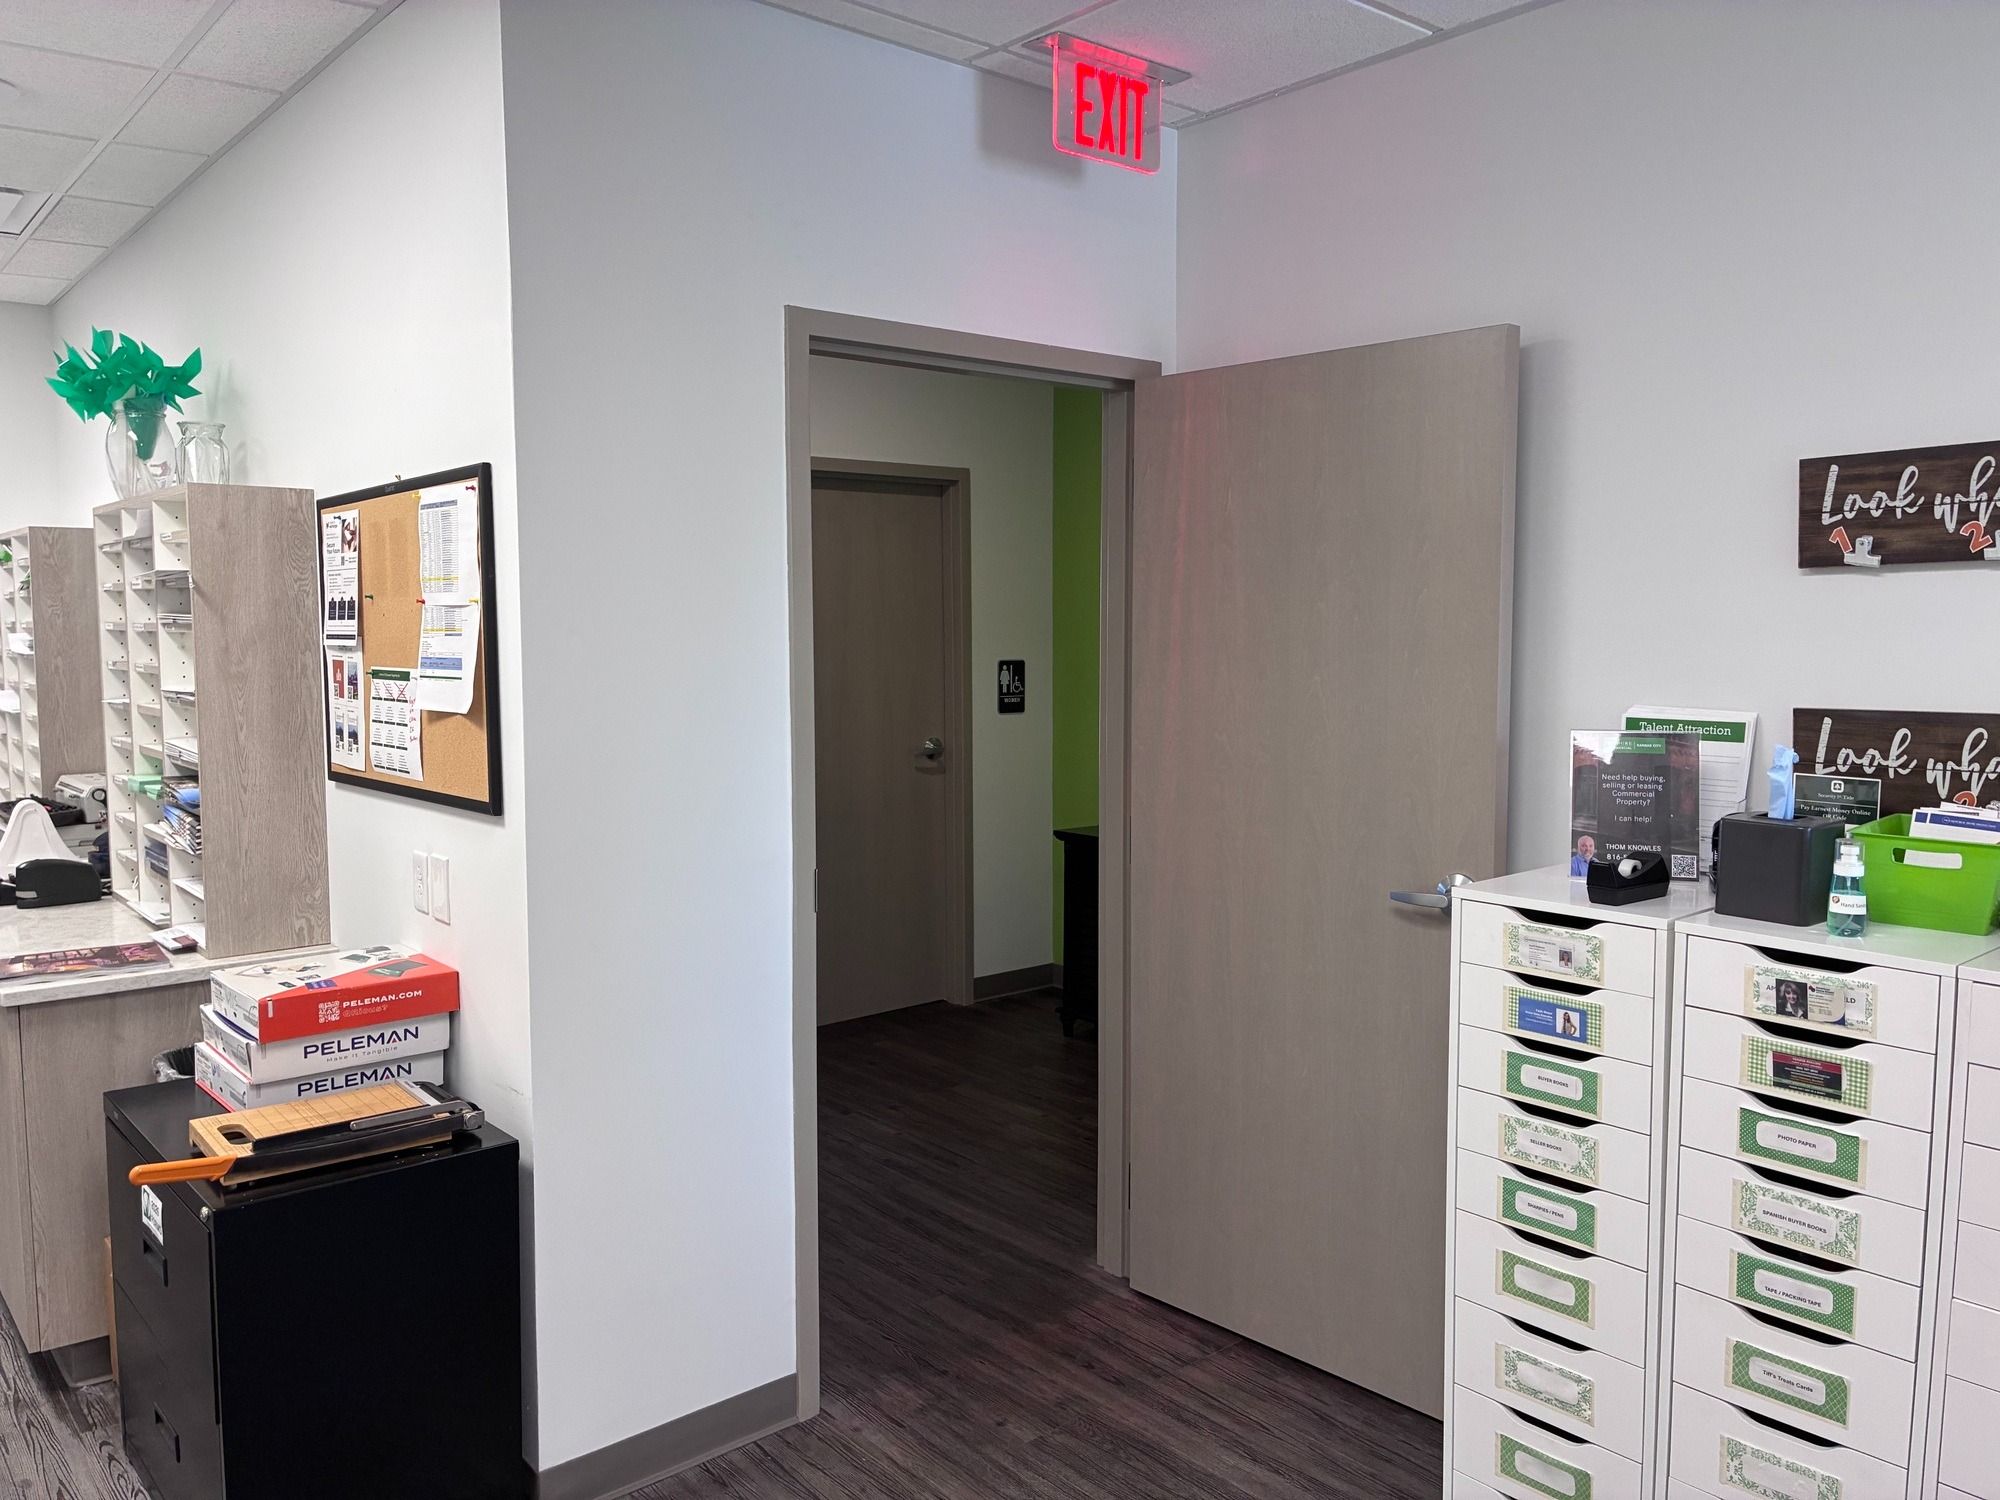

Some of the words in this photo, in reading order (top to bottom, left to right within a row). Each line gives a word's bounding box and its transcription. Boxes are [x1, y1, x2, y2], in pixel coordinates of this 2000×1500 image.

[1074, 61, 1149, 160] EXIT
[1821, 464, 1924, 525] Look
[1828, 525, 1853, 553] 1
[1959, 520, 1993, 553] 2
[1638, 721, 1673, 732] Talent
[1676, 723, 1732, 736] Attraction
[1815, 716, 1917, 779] Look
[1602, 782, 1626, 791] selling
[1637, 783, 1663, 792] leasing
[1622, 774, 1638, 783] help
[1640, 774, 1666, 784] buying,
[1612, 790, 1655, 798] Commercial
[1616, 798, 1651, 807] Property?
[1634, 815, 1652, 824] help!
[1832, 807, 1851, 815] Money
[1851, 808, 1872, 816] Online
[1627, 844, 1662, 852] KNOWLES
[342, 989, 423, 1008] PELEMAN.COM
[303, 1026, 419, 1059] PELEMAN
[326, 1055, 349, 1063] Make
[362, 1046, 398, 1057] Tangible
[297, 1062, 412, 1097] PELEMAN
[1537, 1075, 1553, 1084] BUYER
[1552, 1079, 1569, 1088] BOOKS
[1530, 1138, 1546, 1147] SELLER
[1546, 1143, 1562, 1151] BOOKS
[1777, 1133, 1797, 1143] PHOTO
[1797, 1139, 1817, 1149] PAPER
[1527, 1202, 1549, 1214] SHARPIES
[1551, 1210, 1564, 1218] PENS
[1762, 1209, 1787, 1221] SPANISH
[1787, 1217, 1807, 1228] BUYER
[1806, 1223, 1827, 1234] BOOKS
[1764, 1285, 1778, 1295] TAPE
[1782, 1291, 1807, 1303] PACKING
[1807, 1299, 1822, 1308] TAPE
[1763, 1369, 1777, 1379] Tiff's
[1777, 1375, 1795, 1386] Treats
[1795, 1382, 1814, 1393] Cards
